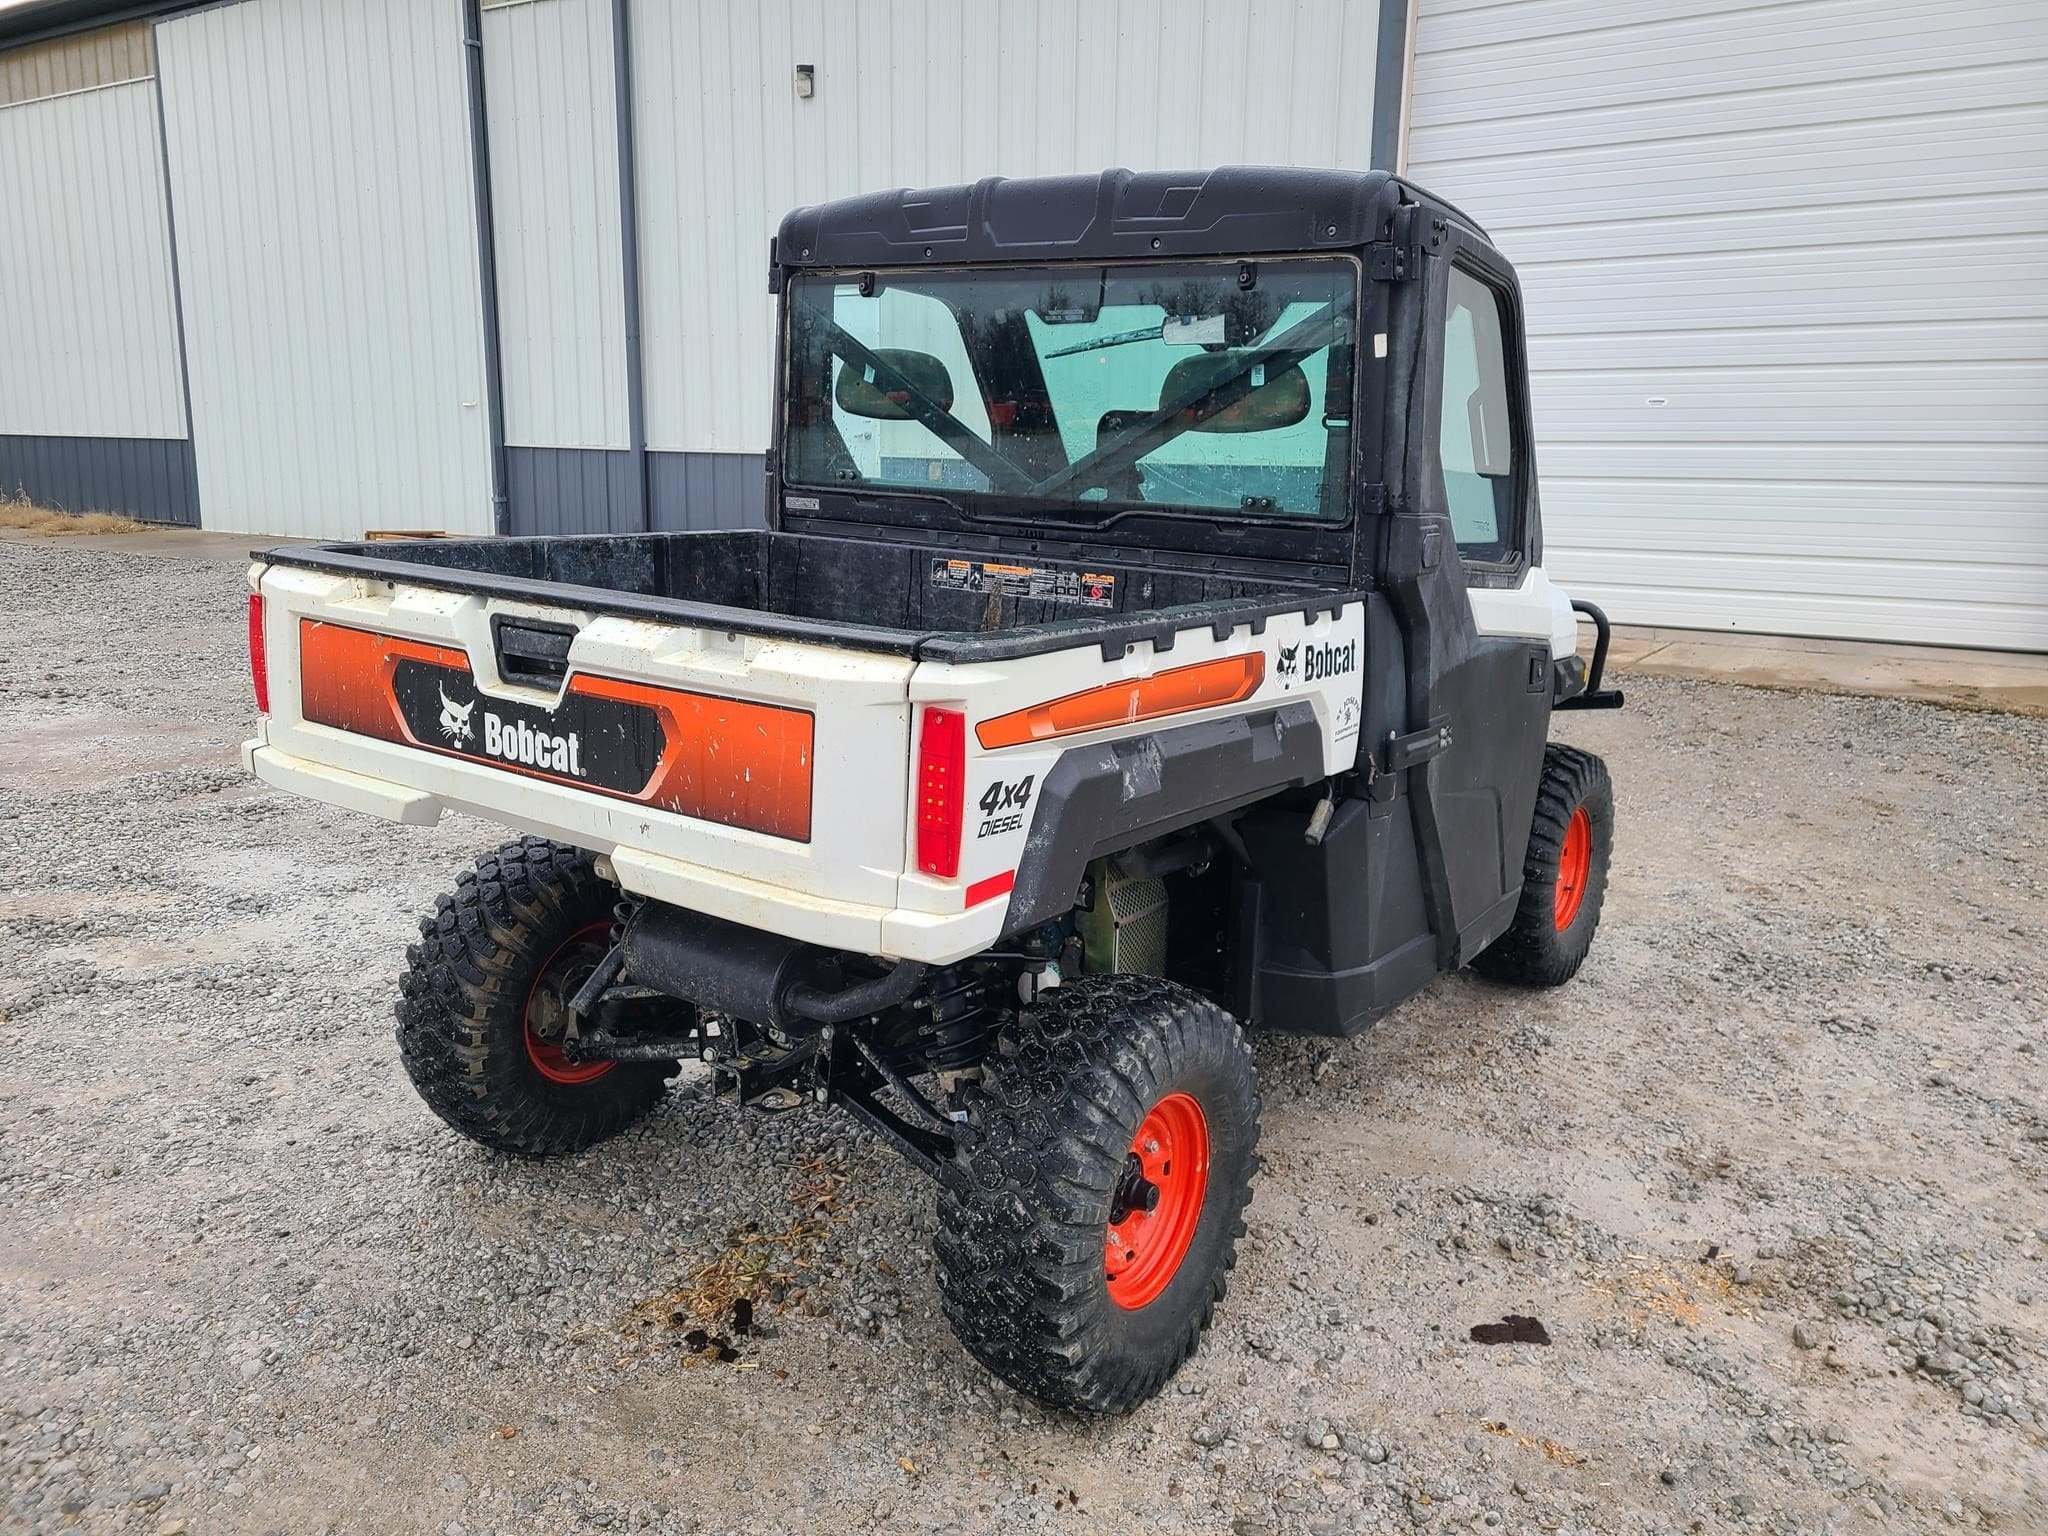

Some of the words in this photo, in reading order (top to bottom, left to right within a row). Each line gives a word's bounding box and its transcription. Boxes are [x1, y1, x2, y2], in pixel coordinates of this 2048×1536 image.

[1305, 638, 1356, 682] Bobcat
[484, 712, 580, 776] Bobcat
[979, 774, 1035, 817] 4x4
[977, 813, 1024, 839] DIESEL
